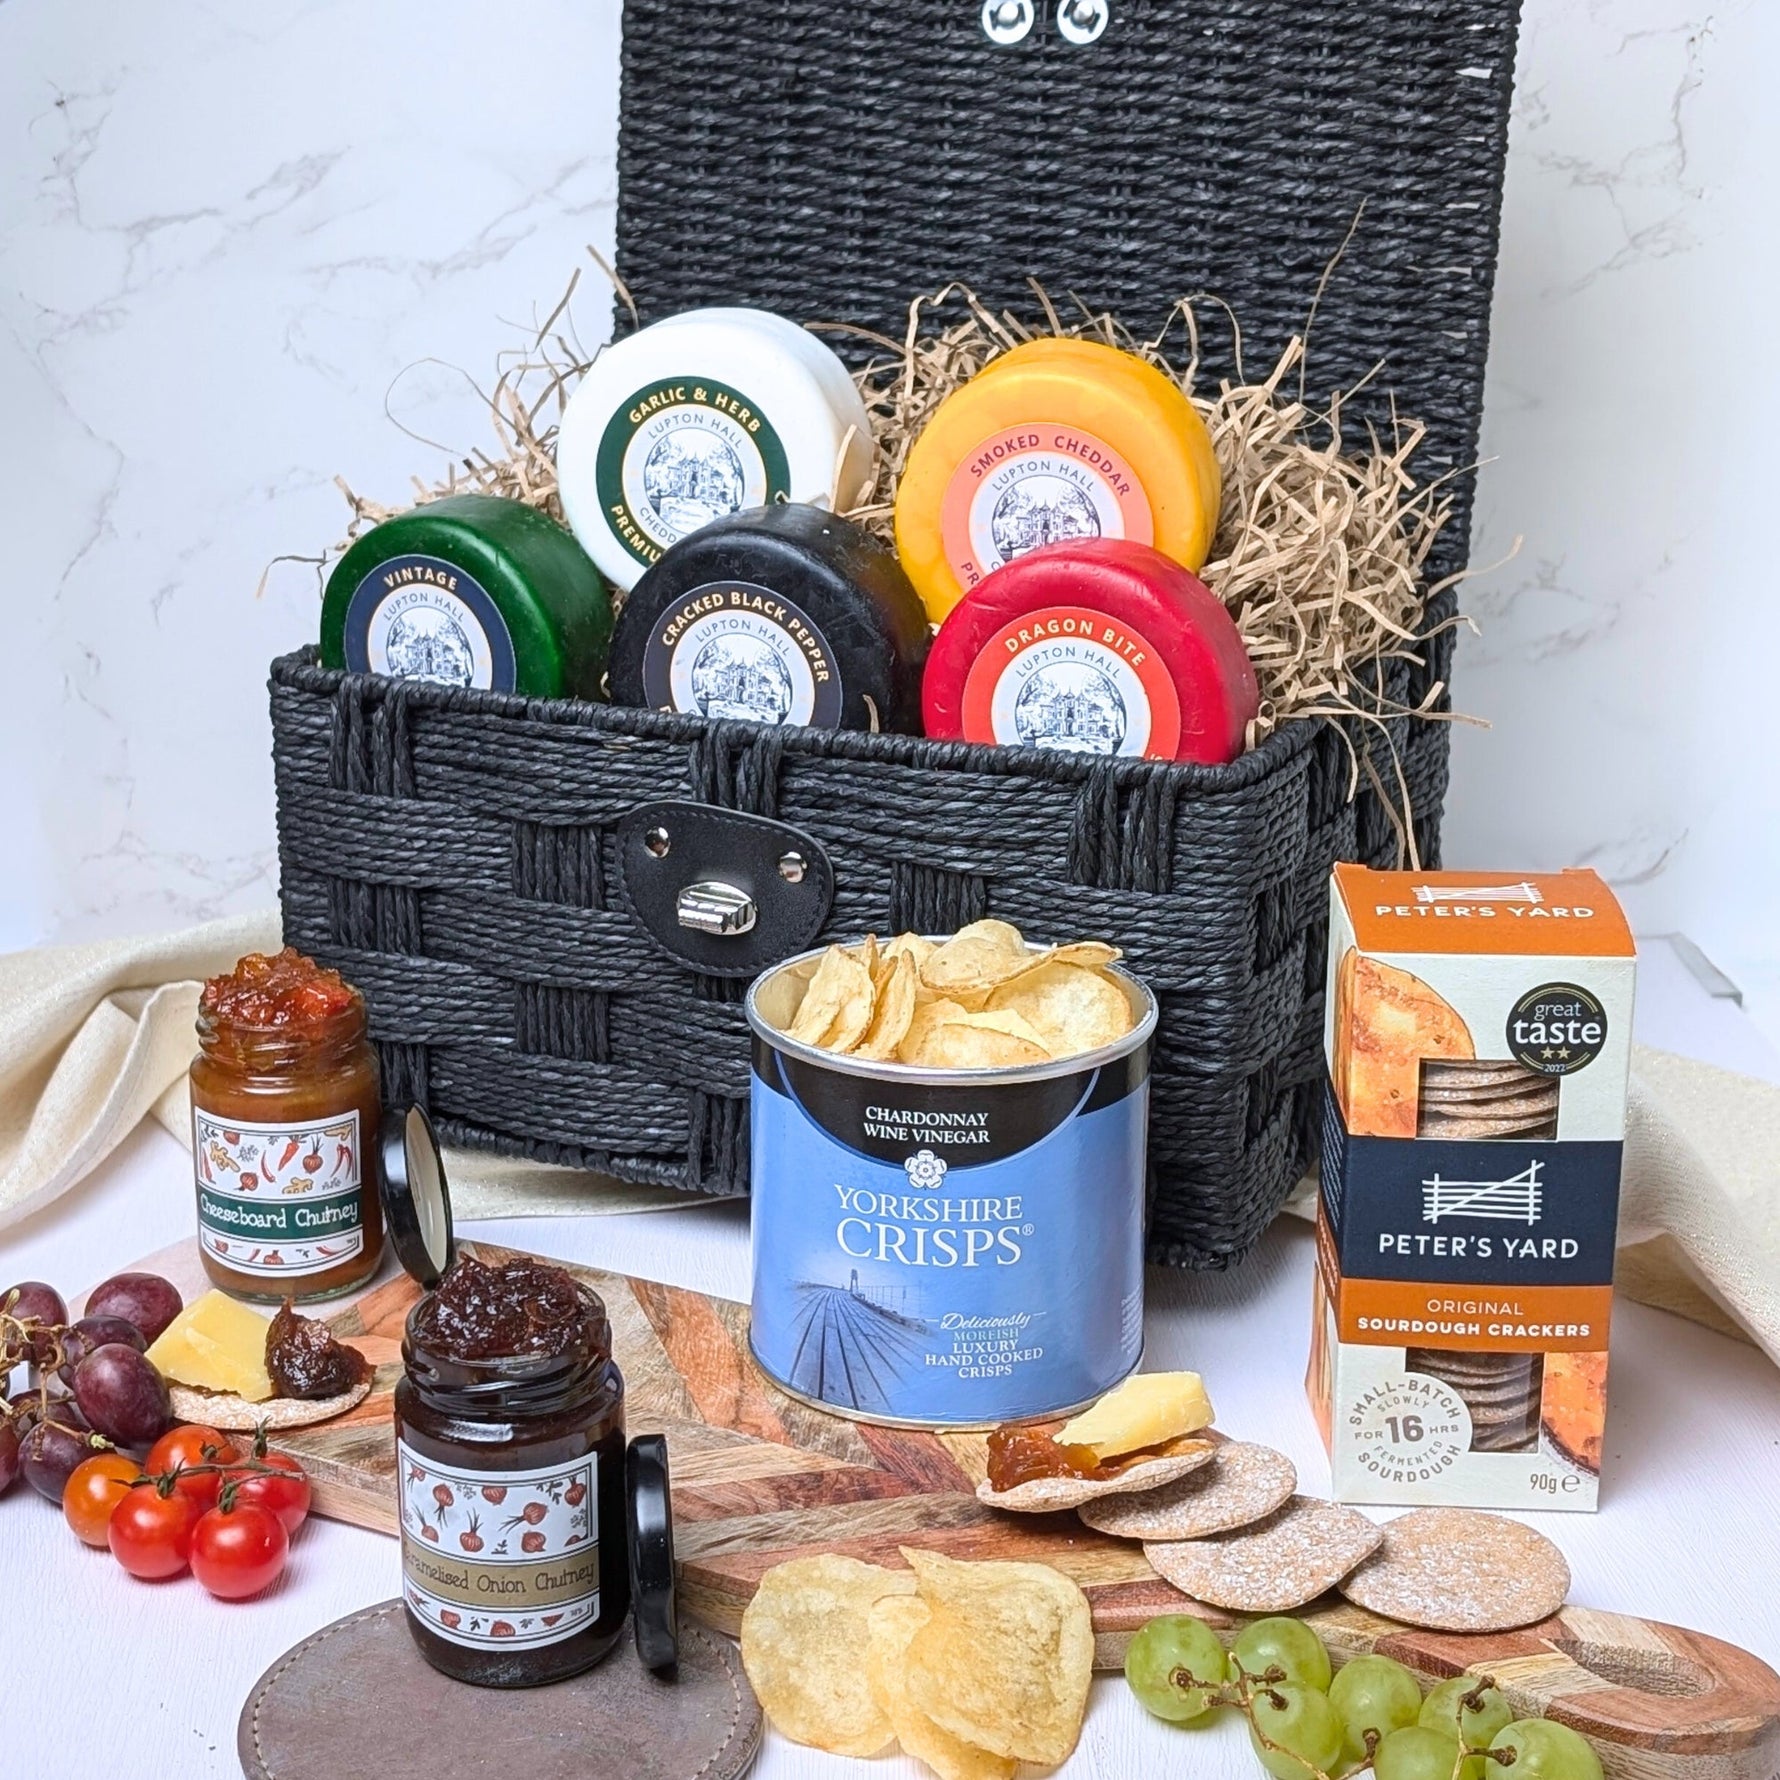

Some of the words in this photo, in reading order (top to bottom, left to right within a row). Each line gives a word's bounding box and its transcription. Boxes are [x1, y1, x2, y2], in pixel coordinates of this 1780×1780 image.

[629, 387, 686, 423] GARLIC
[693, 388, 707, 402] &
[714, 392, 761, 432] HERB
[648, 413, 704, 439] LUPTON
[711, 418, 743, 449] HALL
[970, 434, 1040, 478] SMOKED
[1054, 435, 1130, 496] CHEDDAR
[992, 460, 1050, 491] LUPTON
[1059, 463, 1094, 492] HALL
[611, 505, 662, 562] PREMIU
[639, 507, 678, 544] CHEDD
[383, 566, 458, 590] VINTAGE
[383, 592, 428, 621] LUPTON
[435, 596, 465, 622] HALL
[662, 593, 724, 646] CRACKED
[730, 591, 787, 622] BLACK
[788, 618, 829, 682] PEPPER
[695, 619, 750, 643] LUPTON
[758, 625, 792, 656] HALL
[1005, 618, 1094, 653] DRAGON
[1103, 628, 1146, 667] BITE
[1015, 647, 1076, 678] LUPTON
[1084, 650, 1122, 678] HALL
[1375, 905, 1496, 917] PETER'S
[1507, 907, 1594, 918] YARD
[1534, 1001, 1582, 1021] great
[1512, 1019, 1602, 1044] taste
[865, 1106, 988, 1126] CHARDONNAY
[863, 1122, 909, 1141] WINE
[912, 1129, 990, 1144] VINEGAR
[200, 1193, 287, 1228] Cheeseboard
[295, 1201, 358, 1226] Chutney
[834, 1184, 1023, 1223] YORKSHIRE
[1379, 1233, 1493, 1258] PETER'S
[1502, 1238, 1579, 1259] YARD
[940, 1312, 1031, 1330] Deliciously
[1427, 1299, 1524, 1316] ORIGINAL
[1357, 1317, 1480, 1336] SOURDOUGH
[1487, 1323, 1591, 1337] CRACKERS
[925, 1354, 973, 1366] HAND
[978, 1347, 1043, 1365] COOKED
[953, 1339, 1019, 1354] LUXURY
[958, 1364, 1012, 1379] CRISPS
[1349, 1379, 1461, 1426] SMALL-BATCH
[1377, 1395, 1430, 1413] SLOWLY
[1354, 1431, 1384, 1440] FOR
[1385, 1415, 1424, 1444] 16
[1429, 1424, 1459, 1434] HRS
[1358, 1445, 1461, 1483] SOURDOUGH
[1374, 1440, 1443, 1466] FERMENTED
[1530, 1473, 1557, 1494] 90g
[477, 1574, 526, 1593] Onion
[535, 1562, 595, 1591] Chutney
